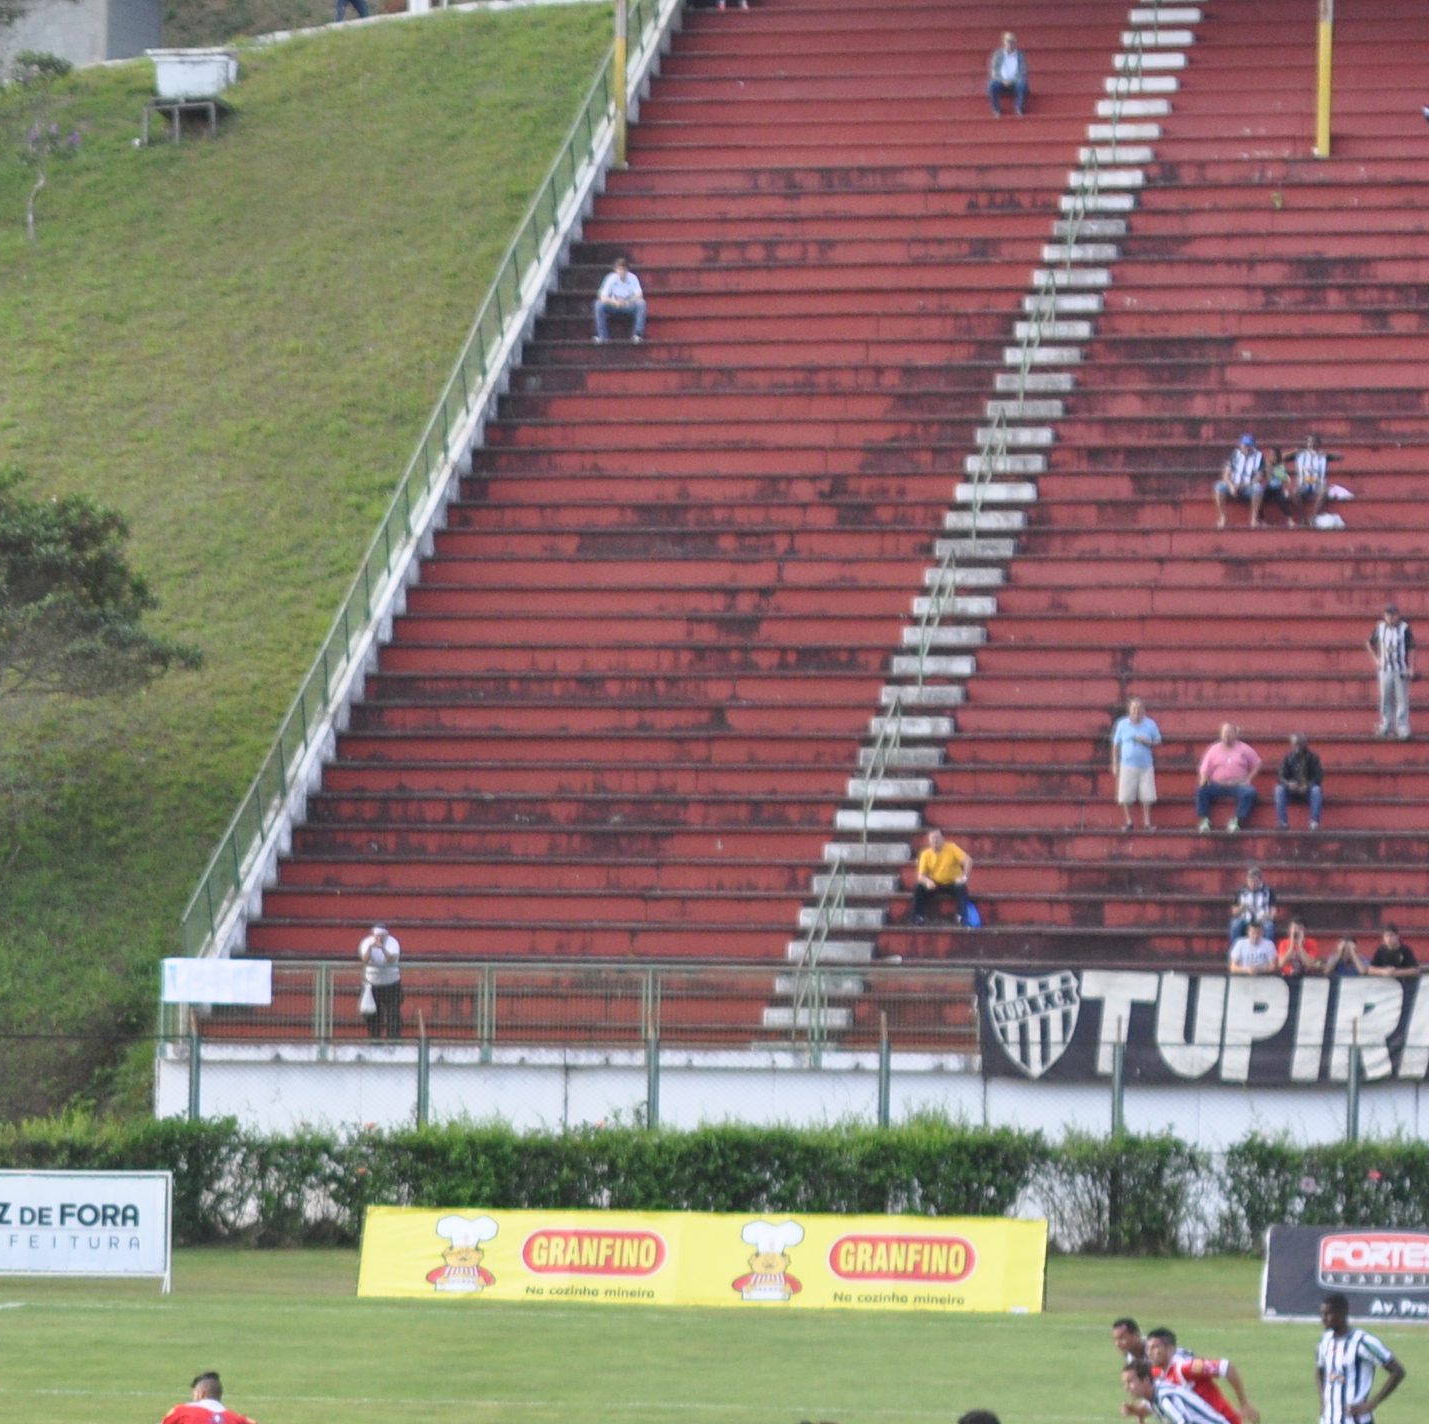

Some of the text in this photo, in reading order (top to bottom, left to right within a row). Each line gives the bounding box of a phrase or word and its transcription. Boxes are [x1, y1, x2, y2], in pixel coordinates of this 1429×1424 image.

[994, 997, 1032, 1023] TUPI
[20, 1206, 53, 1226] DE
[60, 1203, 139, 1227] FORA
[532, 1235, 657, 1269] GRANFINO
[839, 1240, 967, 1276] GRANFINO
[525, 1285, 655, 1299] Na cozinha mineira
[833, 1292, 965, 1305] Na cozinha mineira
